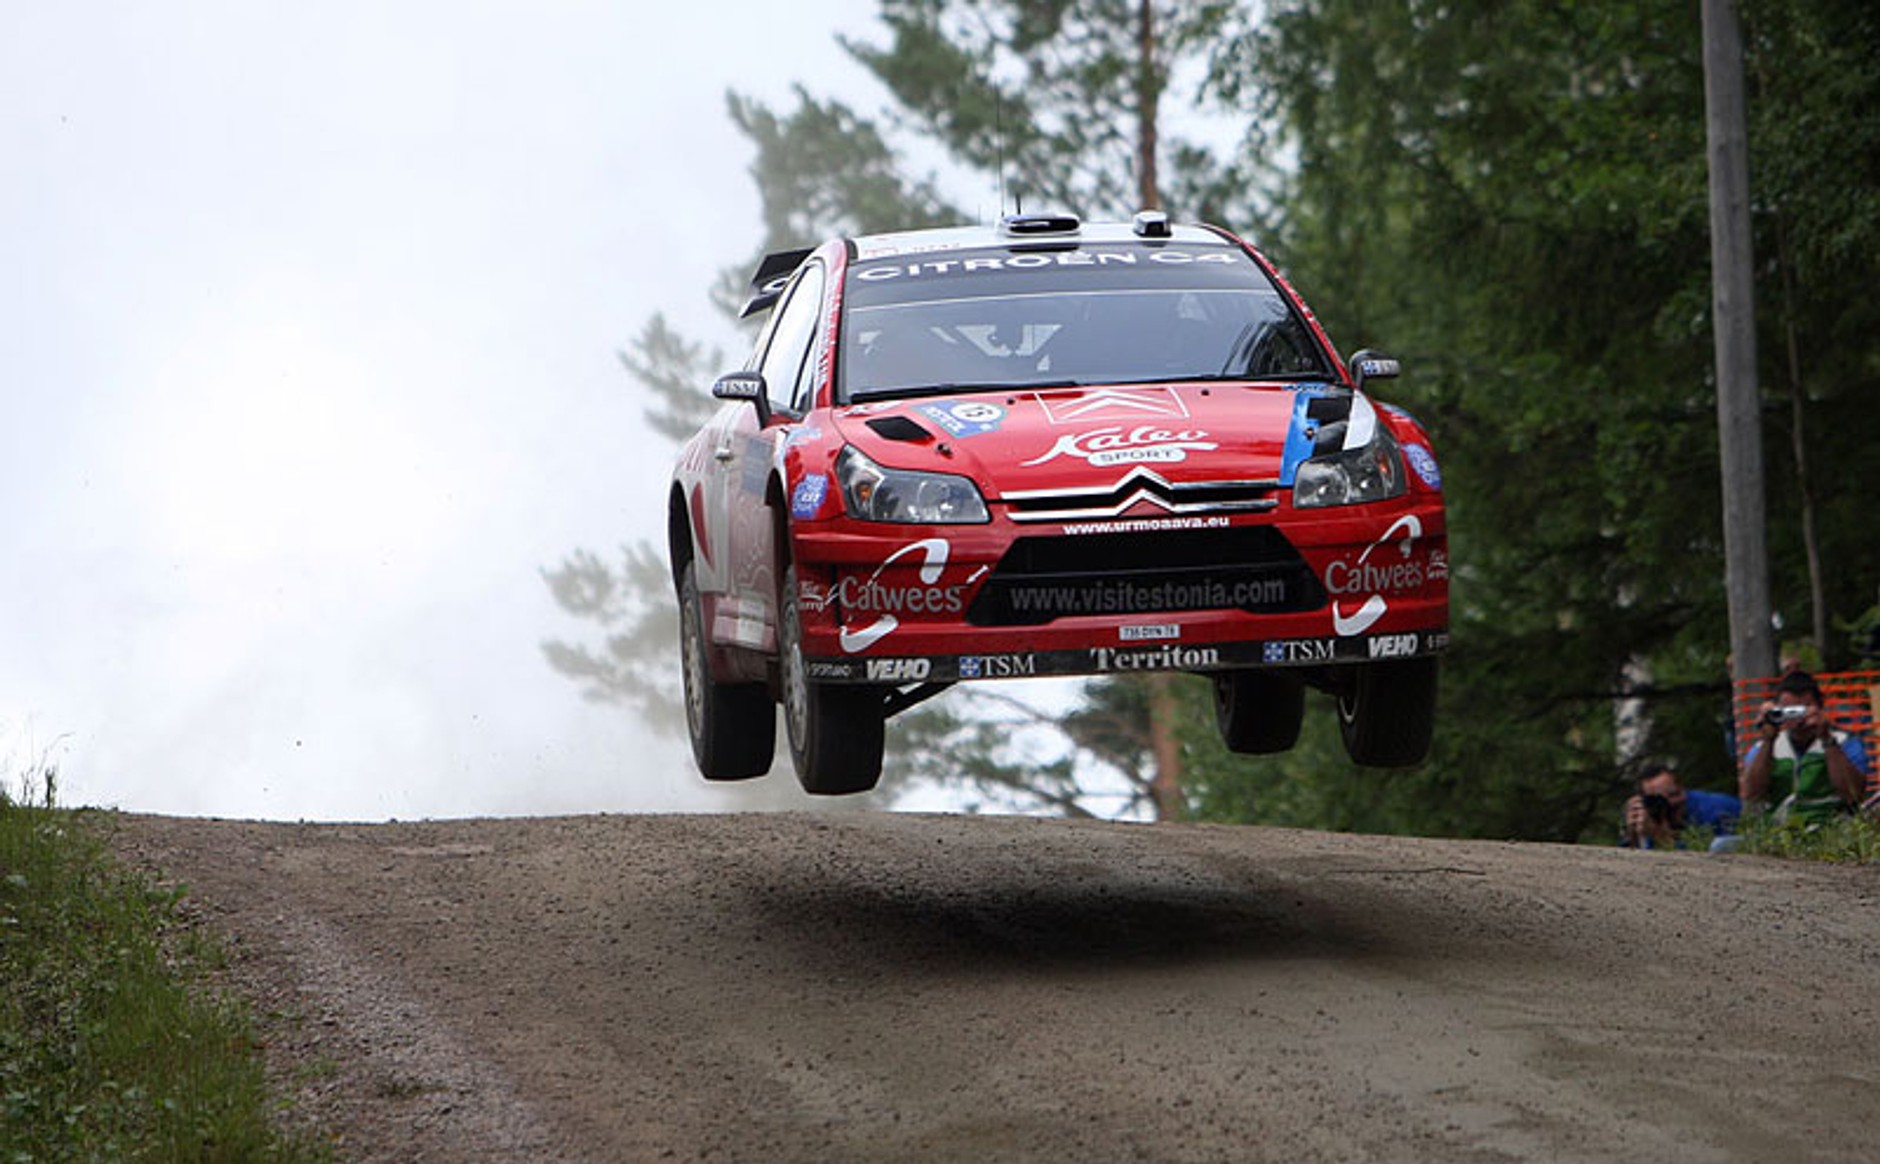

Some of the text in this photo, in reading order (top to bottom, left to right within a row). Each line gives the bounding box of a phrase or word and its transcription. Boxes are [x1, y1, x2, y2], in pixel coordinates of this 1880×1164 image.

[1148, 250, 1240, 266] C4
[1018, 425, 1219, 467] Kalev
[1099, 449, 1173, 463] SPORT
[1062, 516, 1231, 536] www.urmoaava.eu
[1324, 560, 1424, 594] Catwees
[839, 575, 963, 613] Catwees
[1009, 577, 1286, 611] www.visitestonia.com
[1090, 642, 1220, 672] Territon
[1284, 639, 1336, 661] TSM
[1368, 632, 1419, 660] VEHO
[865, 657, 931, 681] VEHO
[981, 654, 1037, 676] TSM
